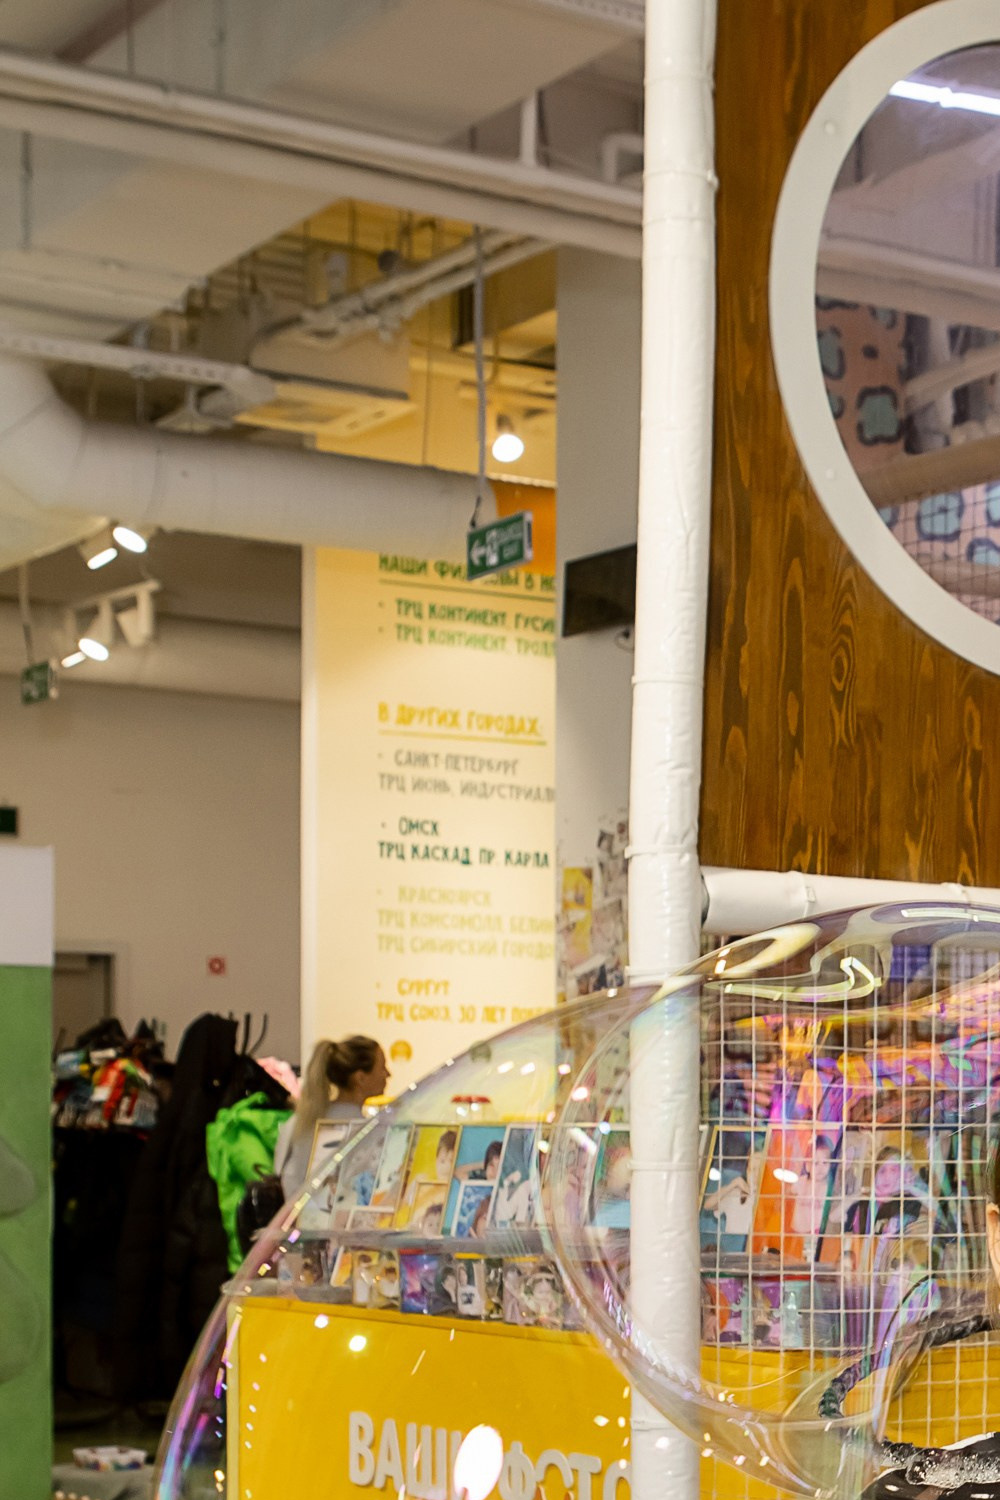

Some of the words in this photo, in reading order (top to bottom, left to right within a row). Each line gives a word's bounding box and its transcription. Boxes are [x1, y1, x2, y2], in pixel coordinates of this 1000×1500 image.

[378, 703, 388, 723] В
[395, 704, 461, 729] ДРУГИХ
[378, 841, 405, 860] ТРЦ
[505, 851, 549, 868] КАРЛА
